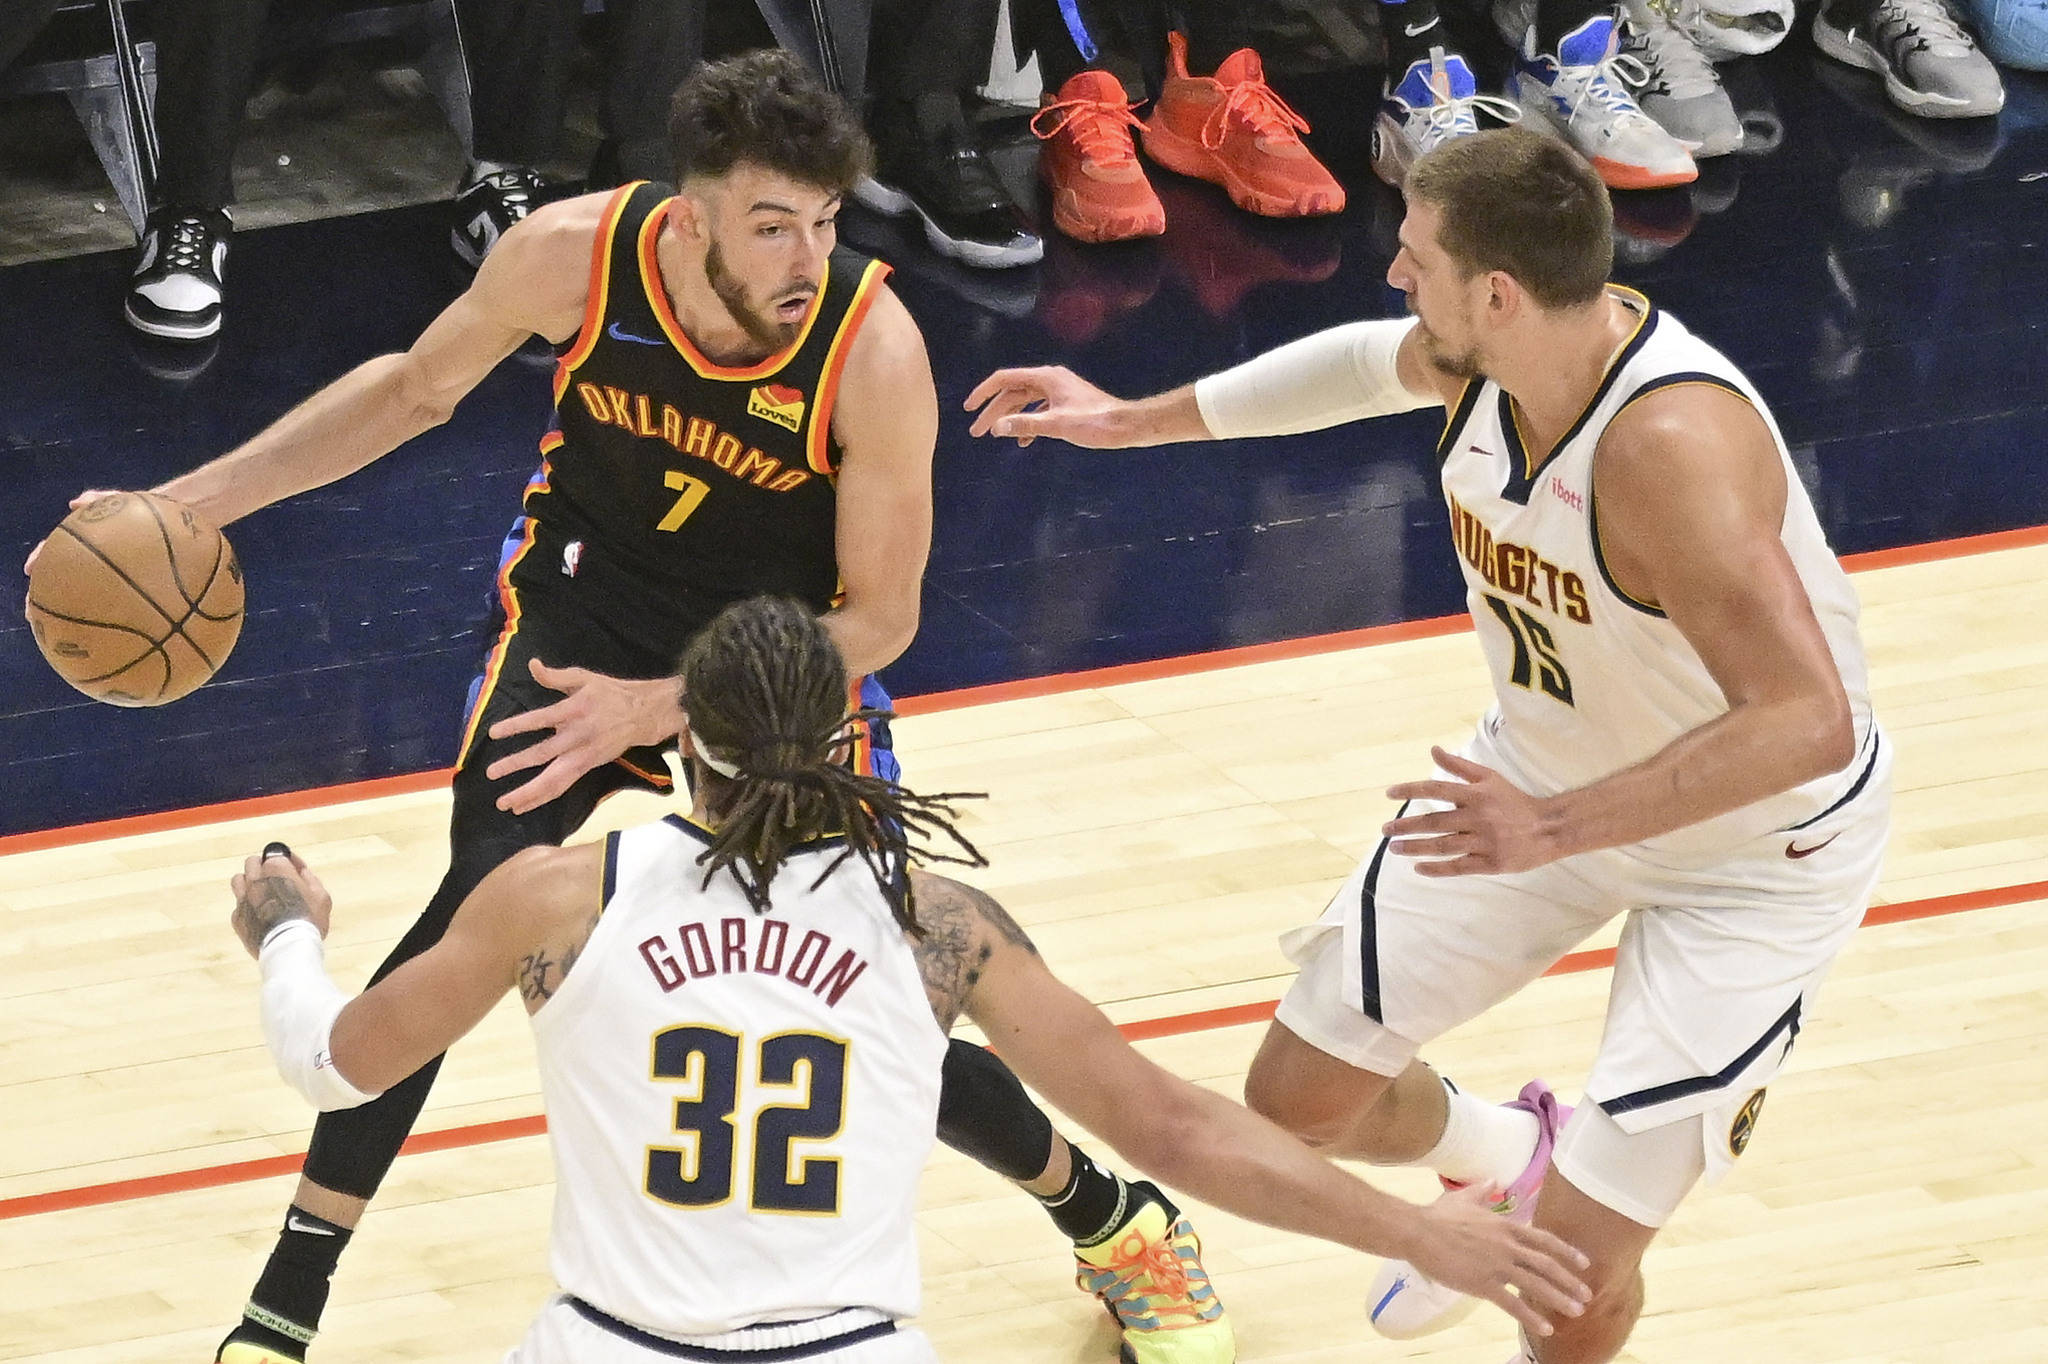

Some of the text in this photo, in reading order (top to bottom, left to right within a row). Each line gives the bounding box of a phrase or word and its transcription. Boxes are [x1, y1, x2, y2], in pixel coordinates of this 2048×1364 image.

[577, 381, 812, 492] OKLAHOMA
[656, 469, 711, 533] 7
[1481, 591, 1576, 709] 15
[637, 916, 869, 1009] GORDON
[642, 1021, 852, 1218] 32
